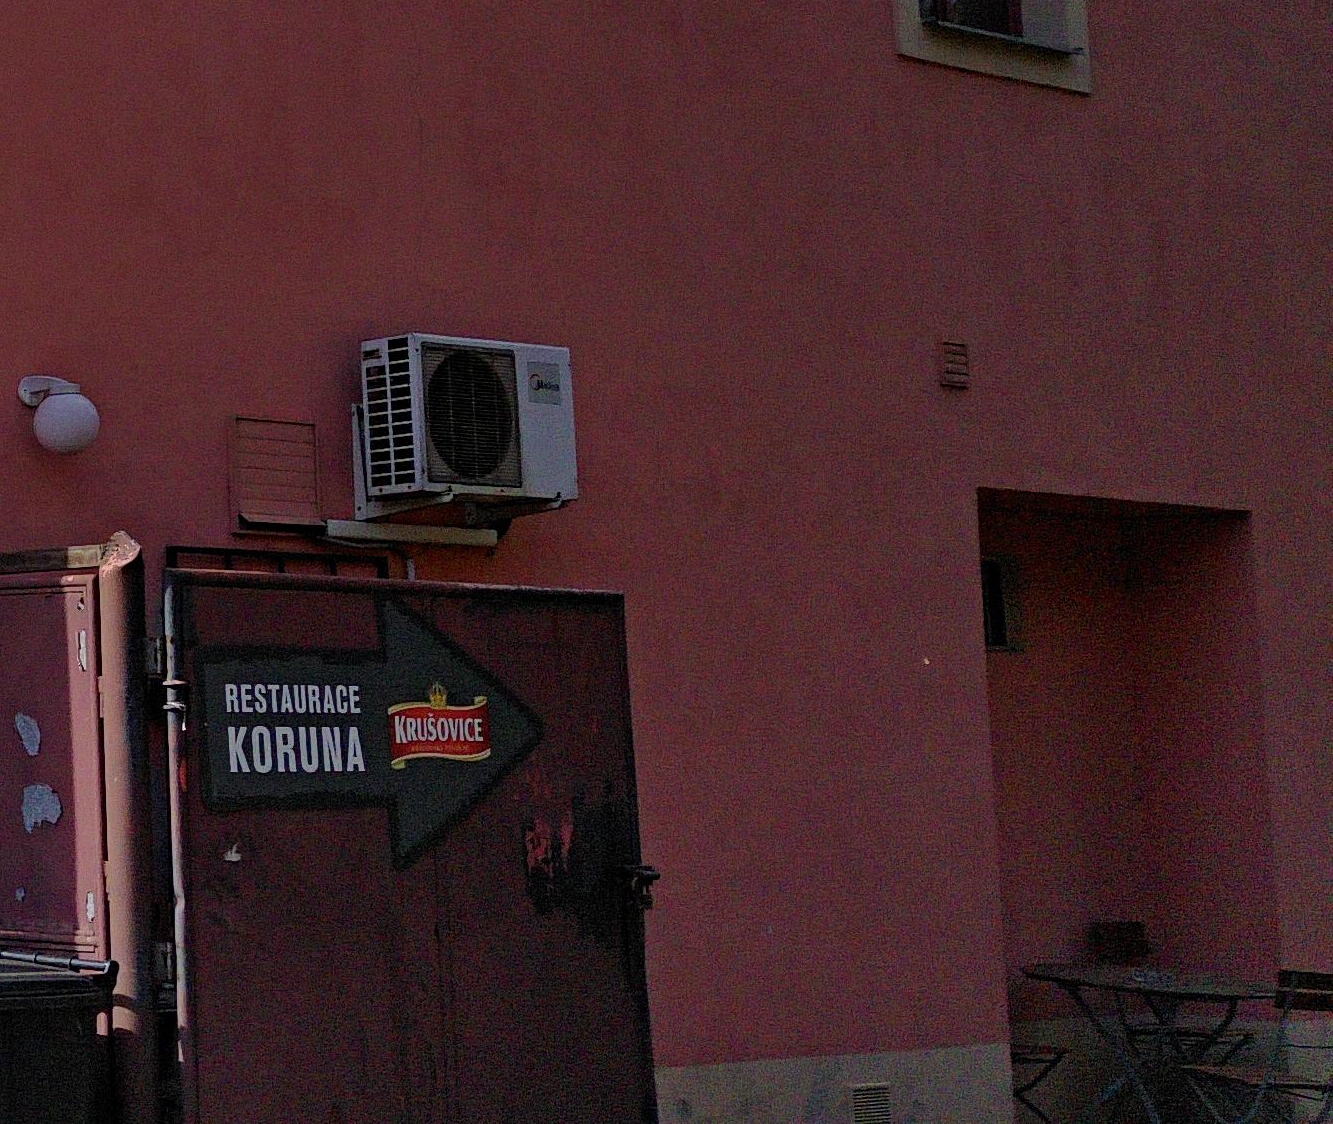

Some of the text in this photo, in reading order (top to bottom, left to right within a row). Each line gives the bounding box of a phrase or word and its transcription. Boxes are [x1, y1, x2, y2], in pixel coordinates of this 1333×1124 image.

[225, 683, 362, 715] RESTAURACE
[394, 713, 484, 744] KRUŠOVICE
[228, 726, 366, 773] KORUNA
